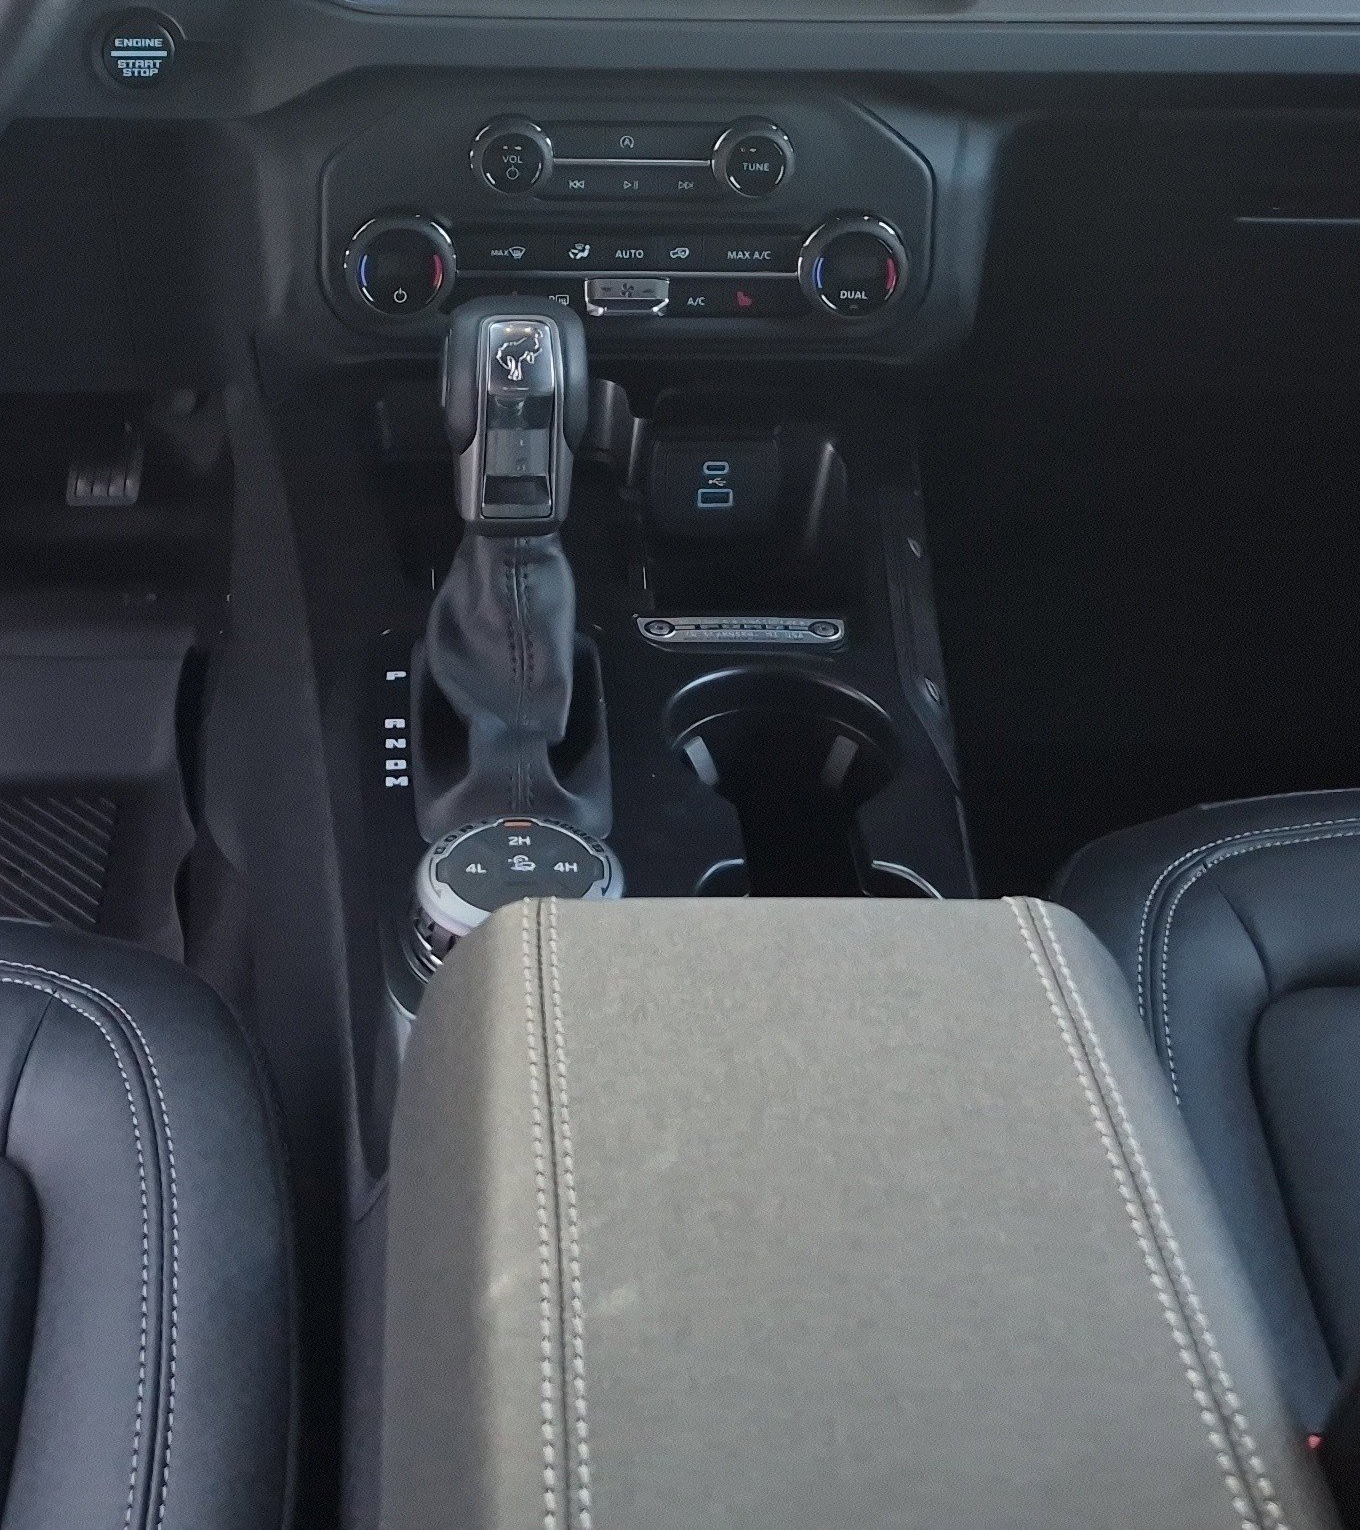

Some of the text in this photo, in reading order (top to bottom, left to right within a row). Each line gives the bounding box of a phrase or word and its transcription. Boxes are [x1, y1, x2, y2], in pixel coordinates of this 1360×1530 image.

[114, 38, 163, 47] ENGINE
[118, 60, 162, 68] START
[123, 69, 159, 77] STOP
[502, 155, 523, 164] VOL
[742, 162, 770, 172] TUNE
[615, 249, 644, 259] AUTO
[727, 250, 772, 260] MAX A/C
[840, 290, 868, 300] DUAL
[687, 296, 706, 306] A/C
[386, 671, 407, 680] P
[385, 738, 406, 749] N
[385, 776, 409, 787] M
[508, 836, 531, 846] 2H
[465, 863, 487, 874] 4L
[553, 862, 578, 873] 4H
